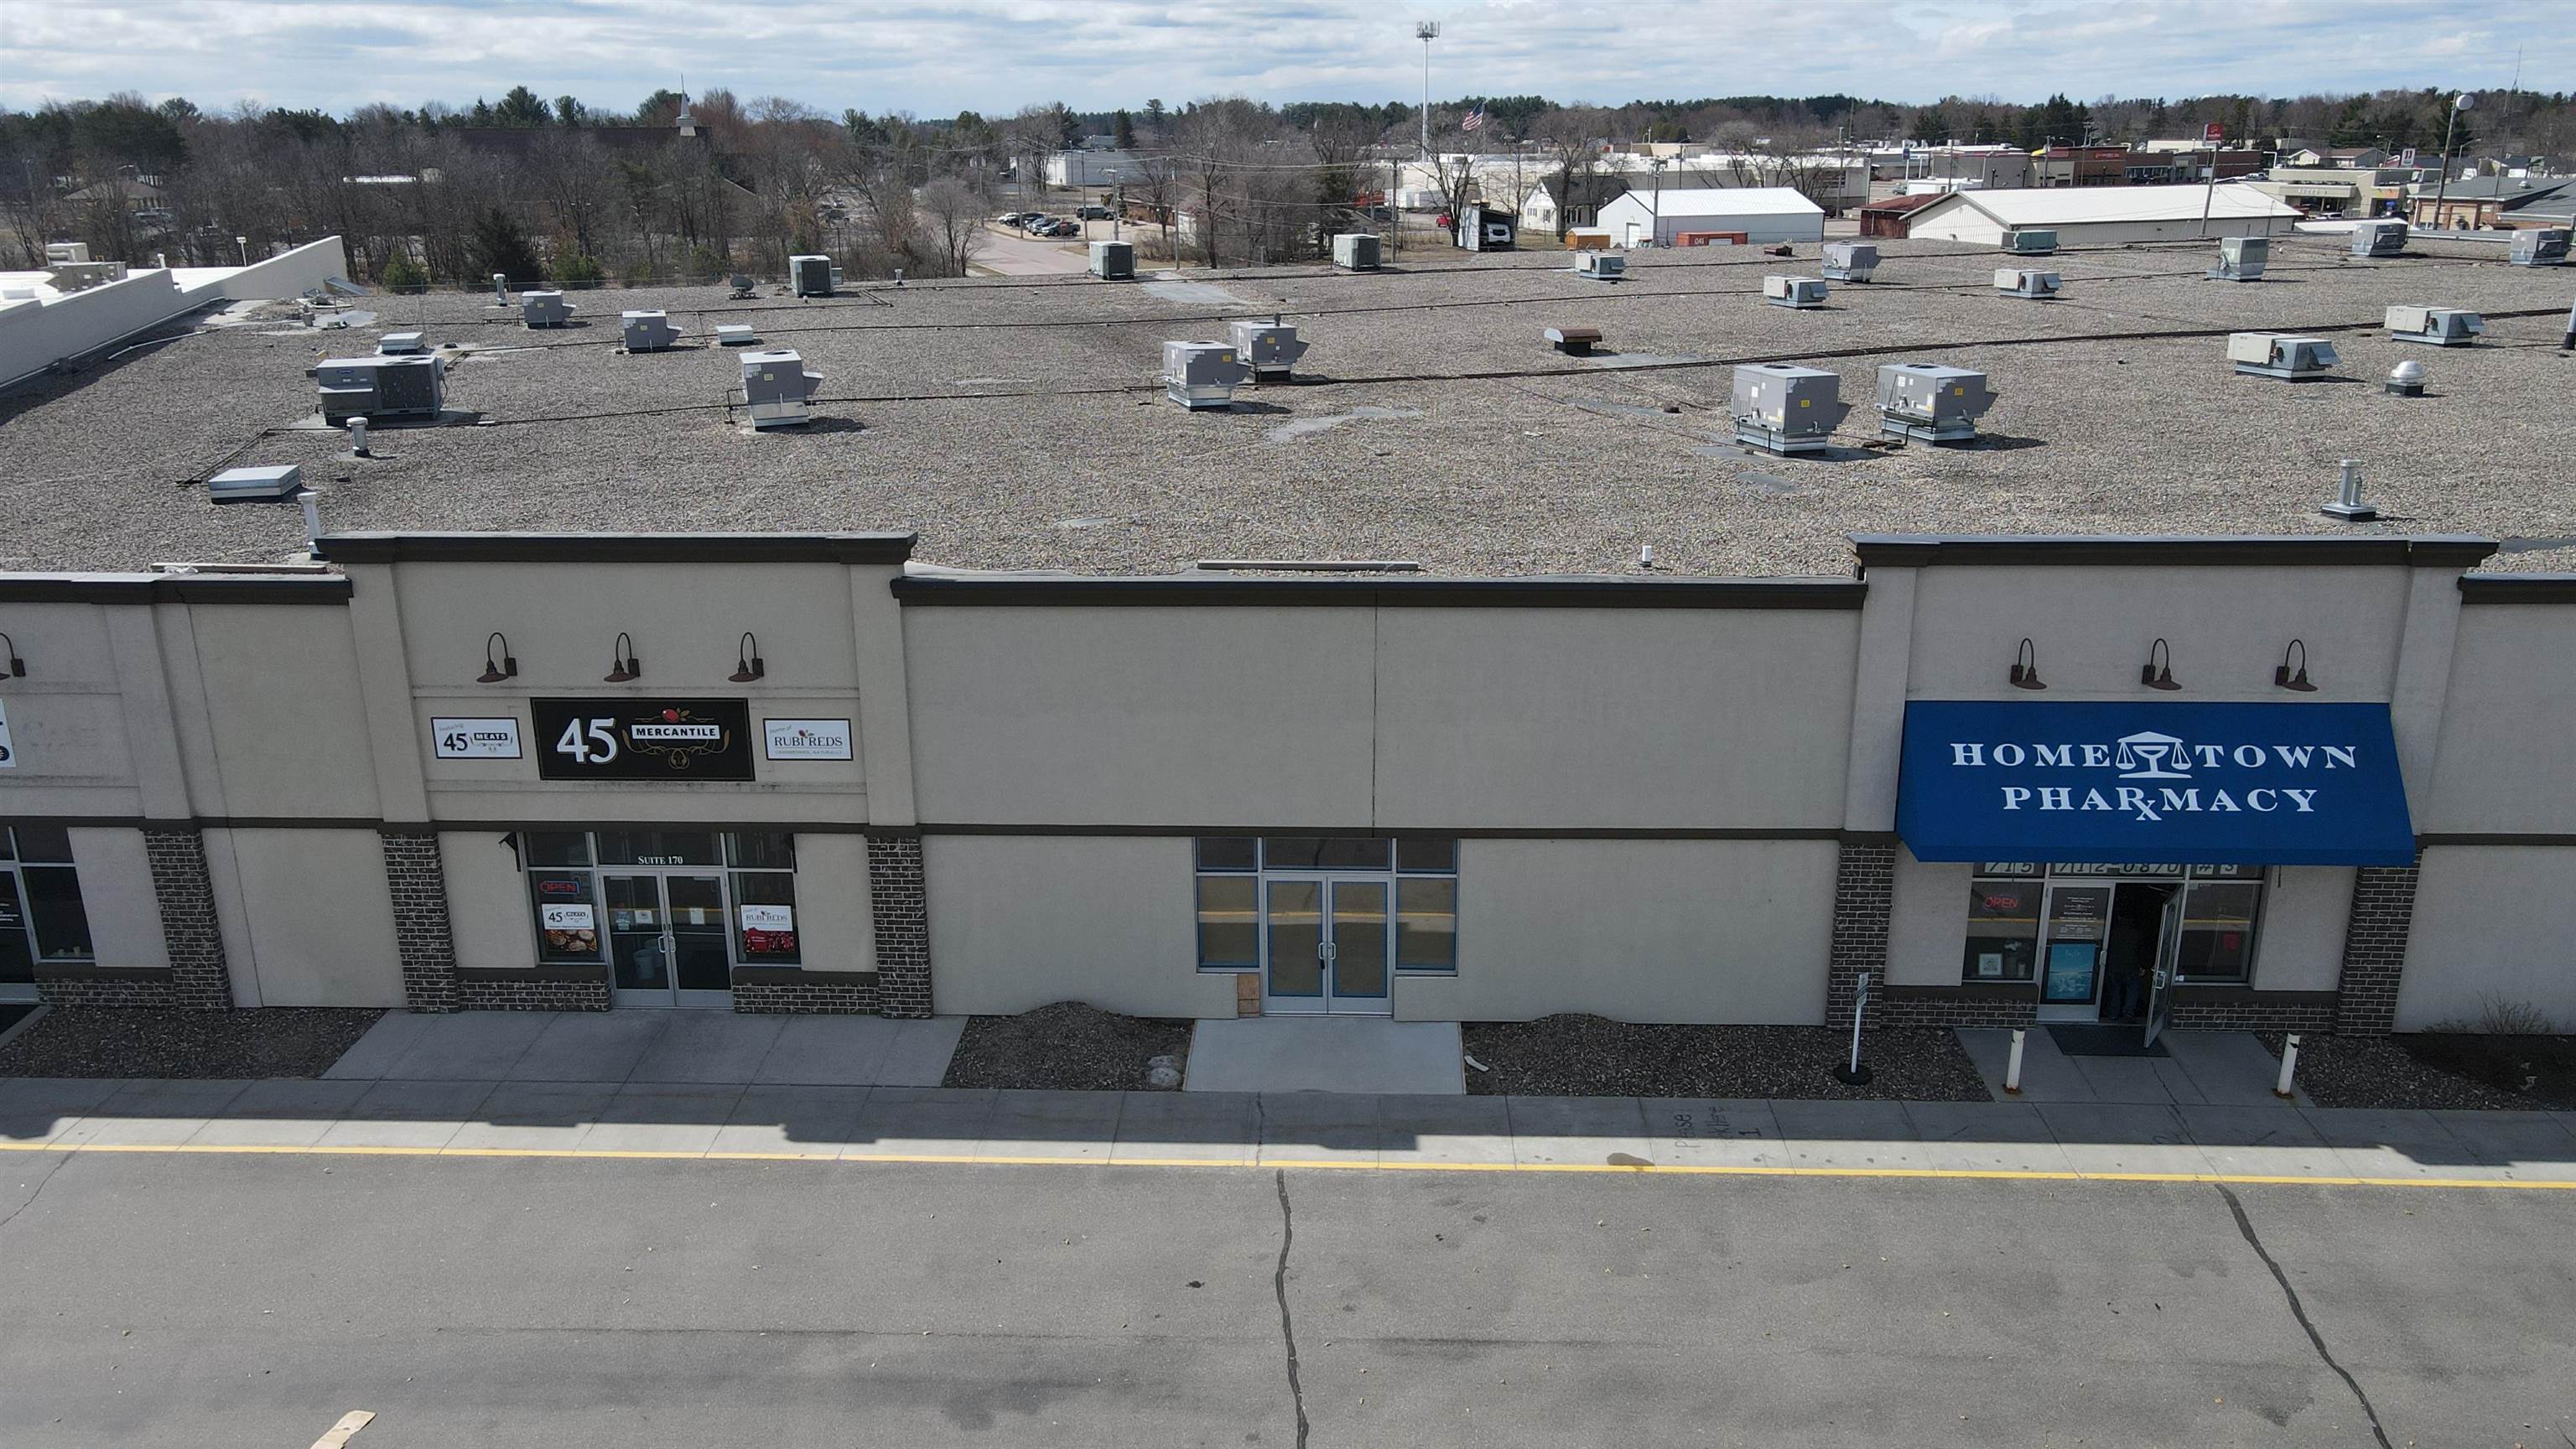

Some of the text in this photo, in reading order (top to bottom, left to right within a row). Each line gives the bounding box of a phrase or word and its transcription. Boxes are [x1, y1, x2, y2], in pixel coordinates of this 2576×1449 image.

[443, 732, 469, 751] 45
[557, 718, 716, 764] 45 MERCANTILE
[774, 737, 844, 746] RUBI REDS
[1950, 743, 2357, 769] HOME TOWN
[668, 856, 683, 865] 170
[539, 883, 577, 893] OPEN
[1985, 896, 2018, 907] OPEN
[548, 911, 564, 922] 45
